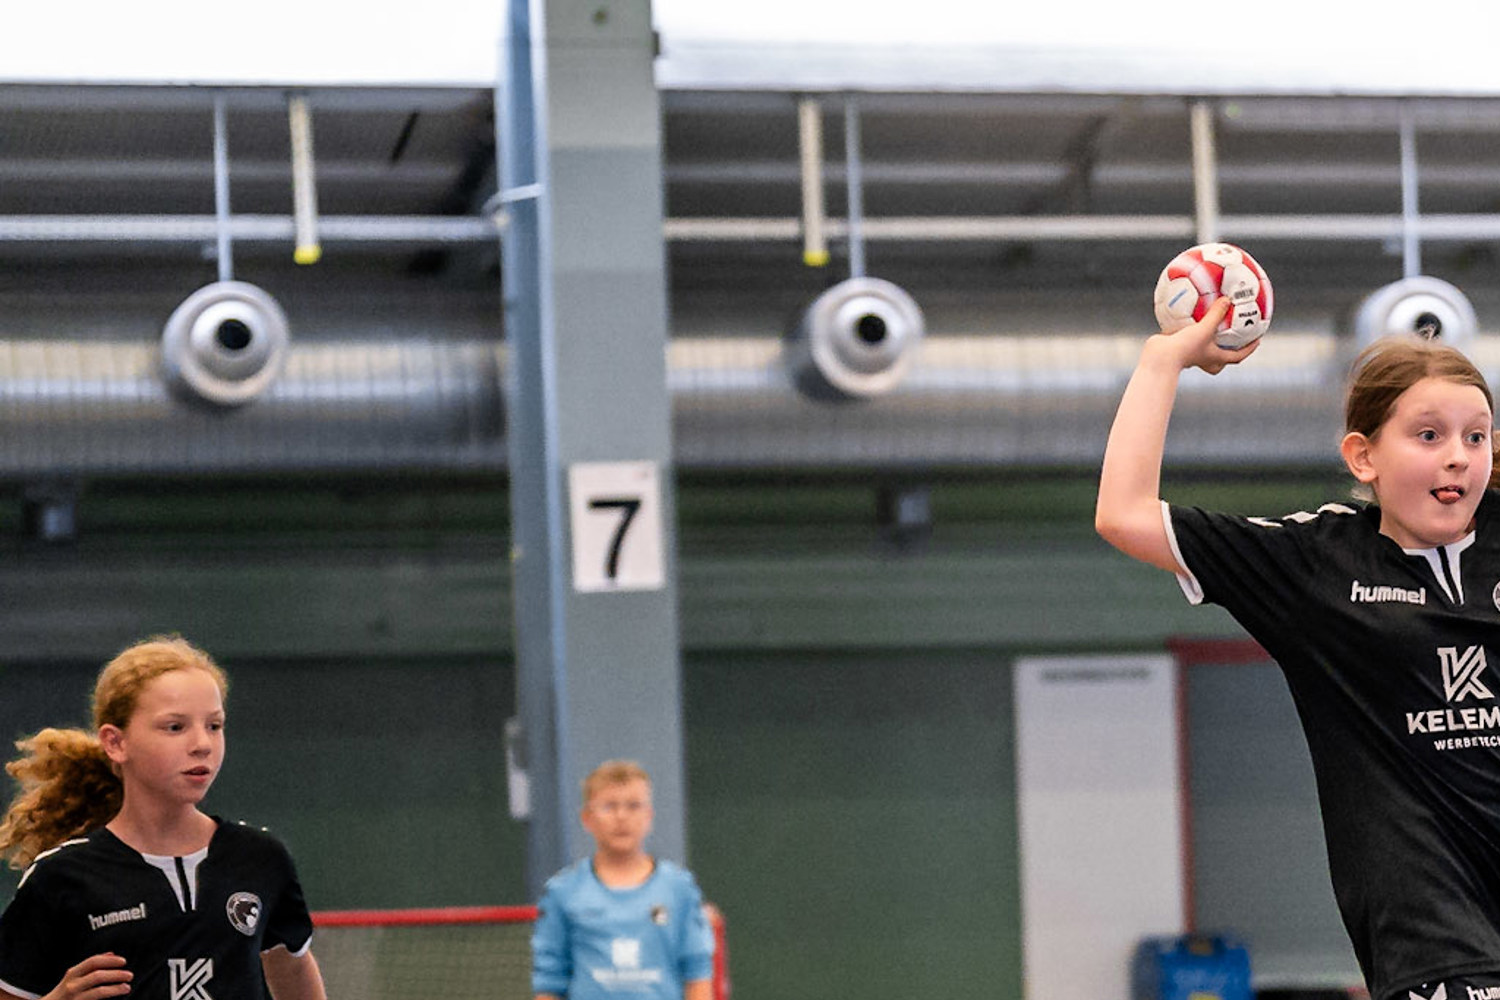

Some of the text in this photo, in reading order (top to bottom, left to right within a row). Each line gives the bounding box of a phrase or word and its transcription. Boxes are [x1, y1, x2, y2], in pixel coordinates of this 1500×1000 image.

[587, 498, 642, 579] 7
[1350, 580, 1427, 606] hummel
[88, 902, 147, 931] hummel
